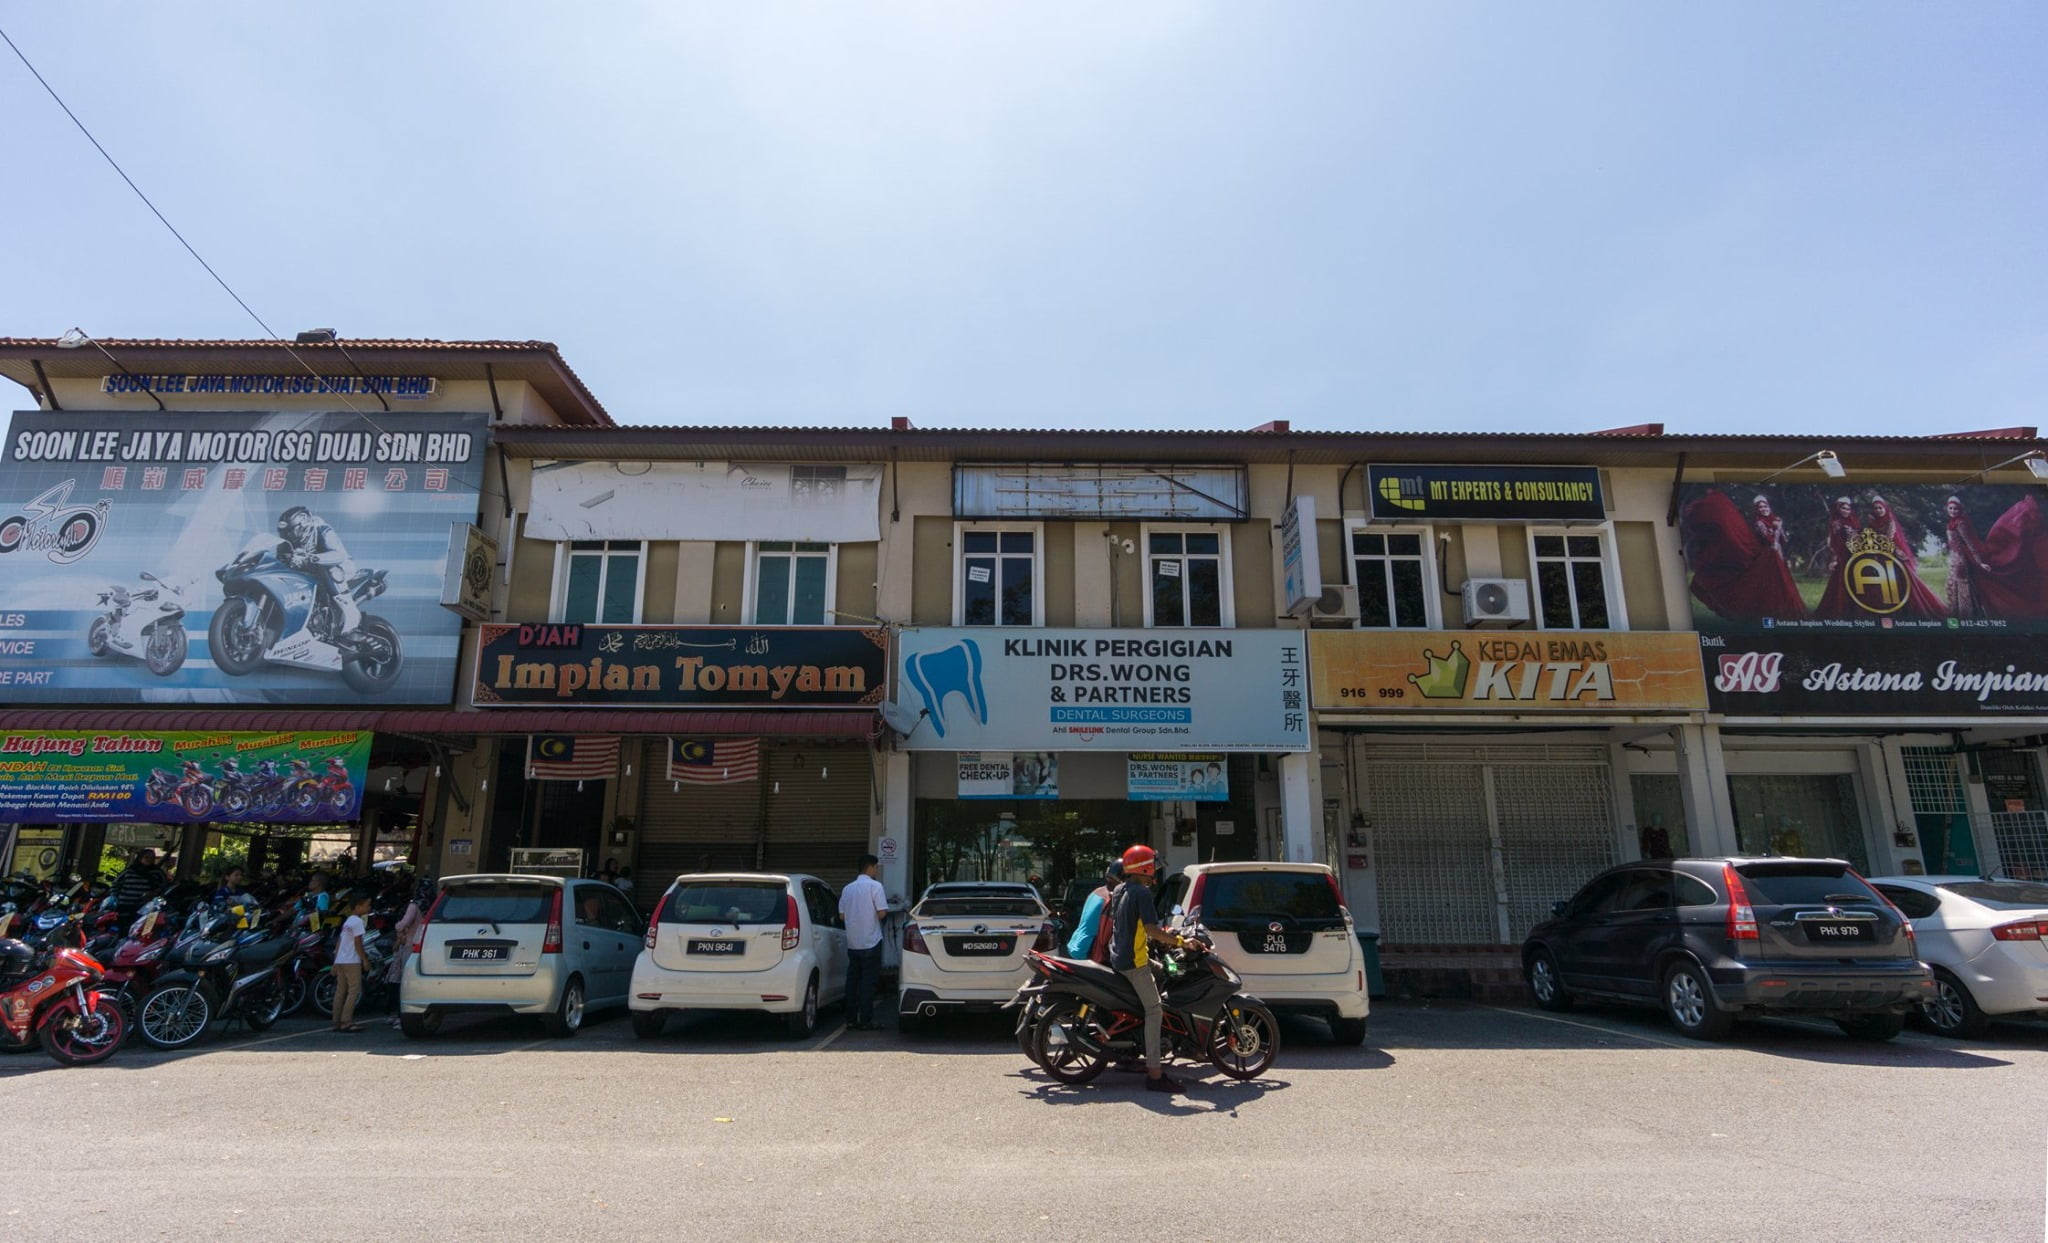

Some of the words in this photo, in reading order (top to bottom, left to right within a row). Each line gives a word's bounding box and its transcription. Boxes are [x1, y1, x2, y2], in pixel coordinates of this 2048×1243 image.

[106, 374, 151, 393] SOON
[156, 375, 186, 393] LEE
[189, 375, 225, 393] JAYA
[230, 375, 284, 393] MOTOR
[318, 376, 355, 395] DUA)
[360, 376, 392, 394] SDN
[396, 377, 429, 394] BHD
[14, 431, 78, 461] SOON
[79, 432, 120, 460] LEE
[121, 432, 183, 461] JAYA
[186, 432, 270, 461] MOTOR
[272, 432, 314, 462] (SG
[316, 432, 372, 462] DUA)
[375, 433, 422, 462] SDN
[425, 433, 471, 462] BHD
[1400, 475, 1424, 496] mt
[1430, 480, 1449, 500] MT
[1451, 481, 1500, 501] EXPERTS
[1504, 482, 1513, 501] &
[1515, 481, 1593, 502] CONSULTANCY
[1853, 559, 1900, 605] AI
[1775, 619, 1798, 628] Astana
[1799, 619, 1823, 629] Impian
[1824, 619, 1853, 629] Wedding
[1895, 619, 1917, 628] Astana
[1918, 619, 1941, 629] Impian
[519, 626, 579, 646] D'JAH
[1004, 639, 1088, 658] KLINIK
[1095, 640, 1233, 658] PERGIGIAN
[1478, 641, 1543, 661] KEDAI
[1547, 641, 1608, 662] EMAS
[14, 671, 54, 685] PART
[495, 654, 661, 697] Impian
[675, 656, 866, 699] Tomyam
[1050, 664, 1191, 682] DRS.WONG
[1473, 662, 1616, 701] KITA
[1802, 662, 1924, 692] Astana
[1050, 686, 1067, 703] &
[1074, 687, 1192, 704] PARTNERS
[1281, 647, 1304, 733] 王牙醫所
[1340, 688, 1366, 698] 916
[1378, 688, 1404, 698] 999
[1056, 710, 1106, 720] DENTAL
[1111, 710, 1185, 721] SURGEONS
[1132, 727, 1156, 735] Group
[2, 736, 87, 756] Hujung
[93, 735, 164, 753] Tahun
[960, 771, 1010, 780] CHECK-UP
[88, 792, 132, 800] RM100
[1820, 926, 1839, 936] PHX
[1840, 925, 1860, 936] 979
[462, 949, 480, 959] PHK
[482, 949, 497, 959] 361
[697, 942, 714, 952] PKN
[714, 942, 734, 952] 9641
[1263, 943, 1287, 952] 3478
